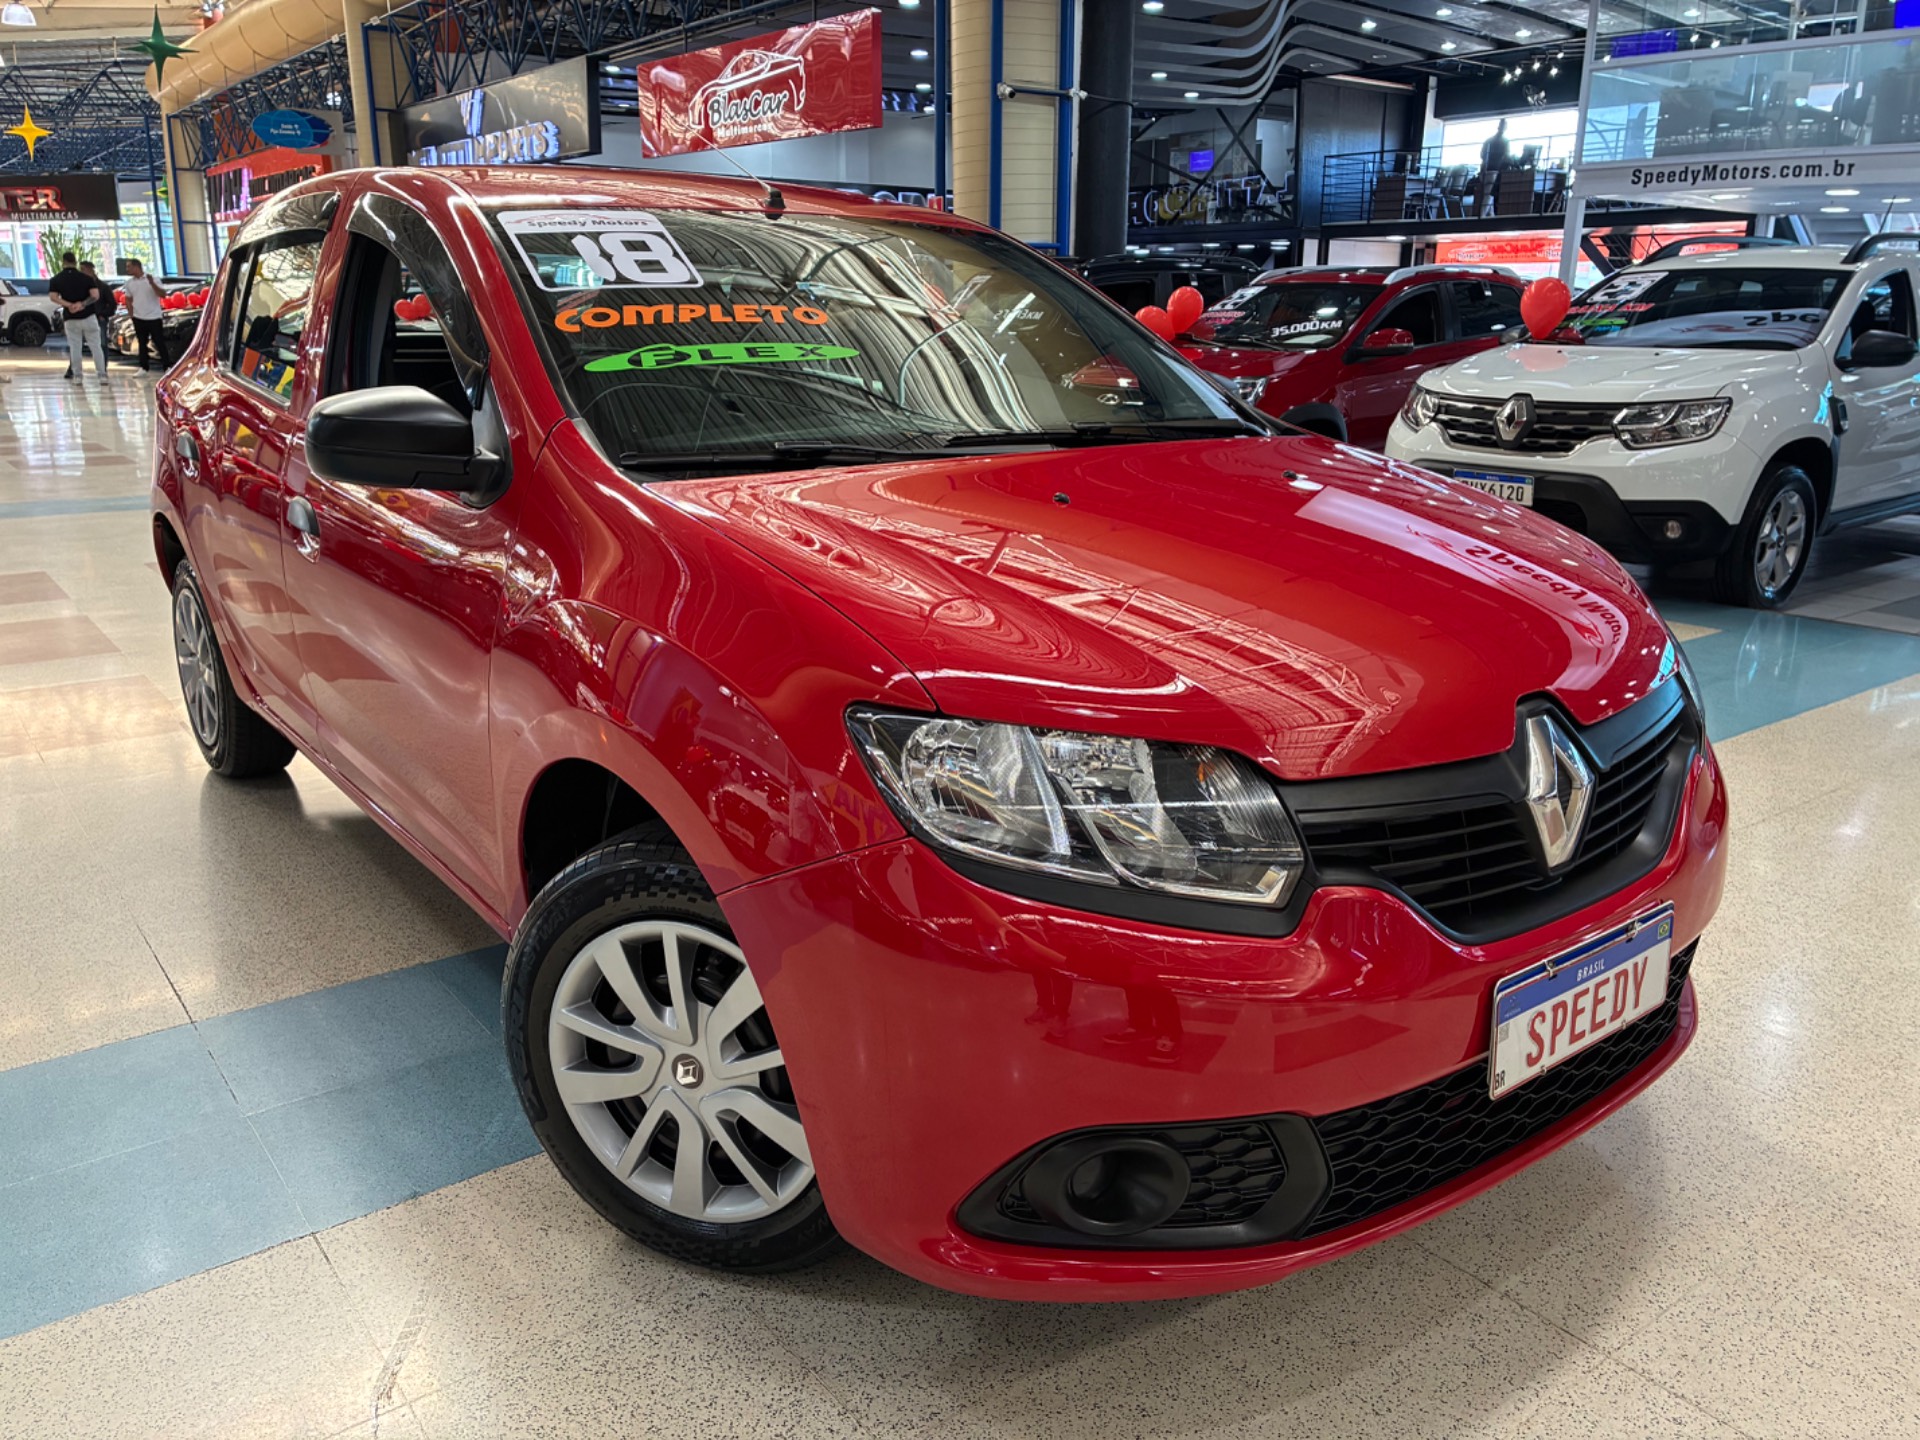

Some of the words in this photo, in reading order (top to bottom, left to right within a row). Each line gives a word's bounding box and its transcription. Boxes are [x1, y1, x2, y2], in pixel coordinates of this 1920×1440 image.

[707, 90, 790, 128] BlasCar
[1630, 159, 1857, 188] SpeedyMotors.com.br
[11, 211, 79, 220] MULTIMARCAS
[527, 218, 588, 228] Speedy
[592, 218, 649, 227] Motors
[571, 232, 691, 283] 18
[554, 303, 829, 332] COMPLETO
[640, 345, 828, 368] FLEX
[1576, 958, 1606, 982] BRASIL
[1526, 956, 1648, 1068] SPEEDY
[1494, 1070, 1506, 1091] BR
